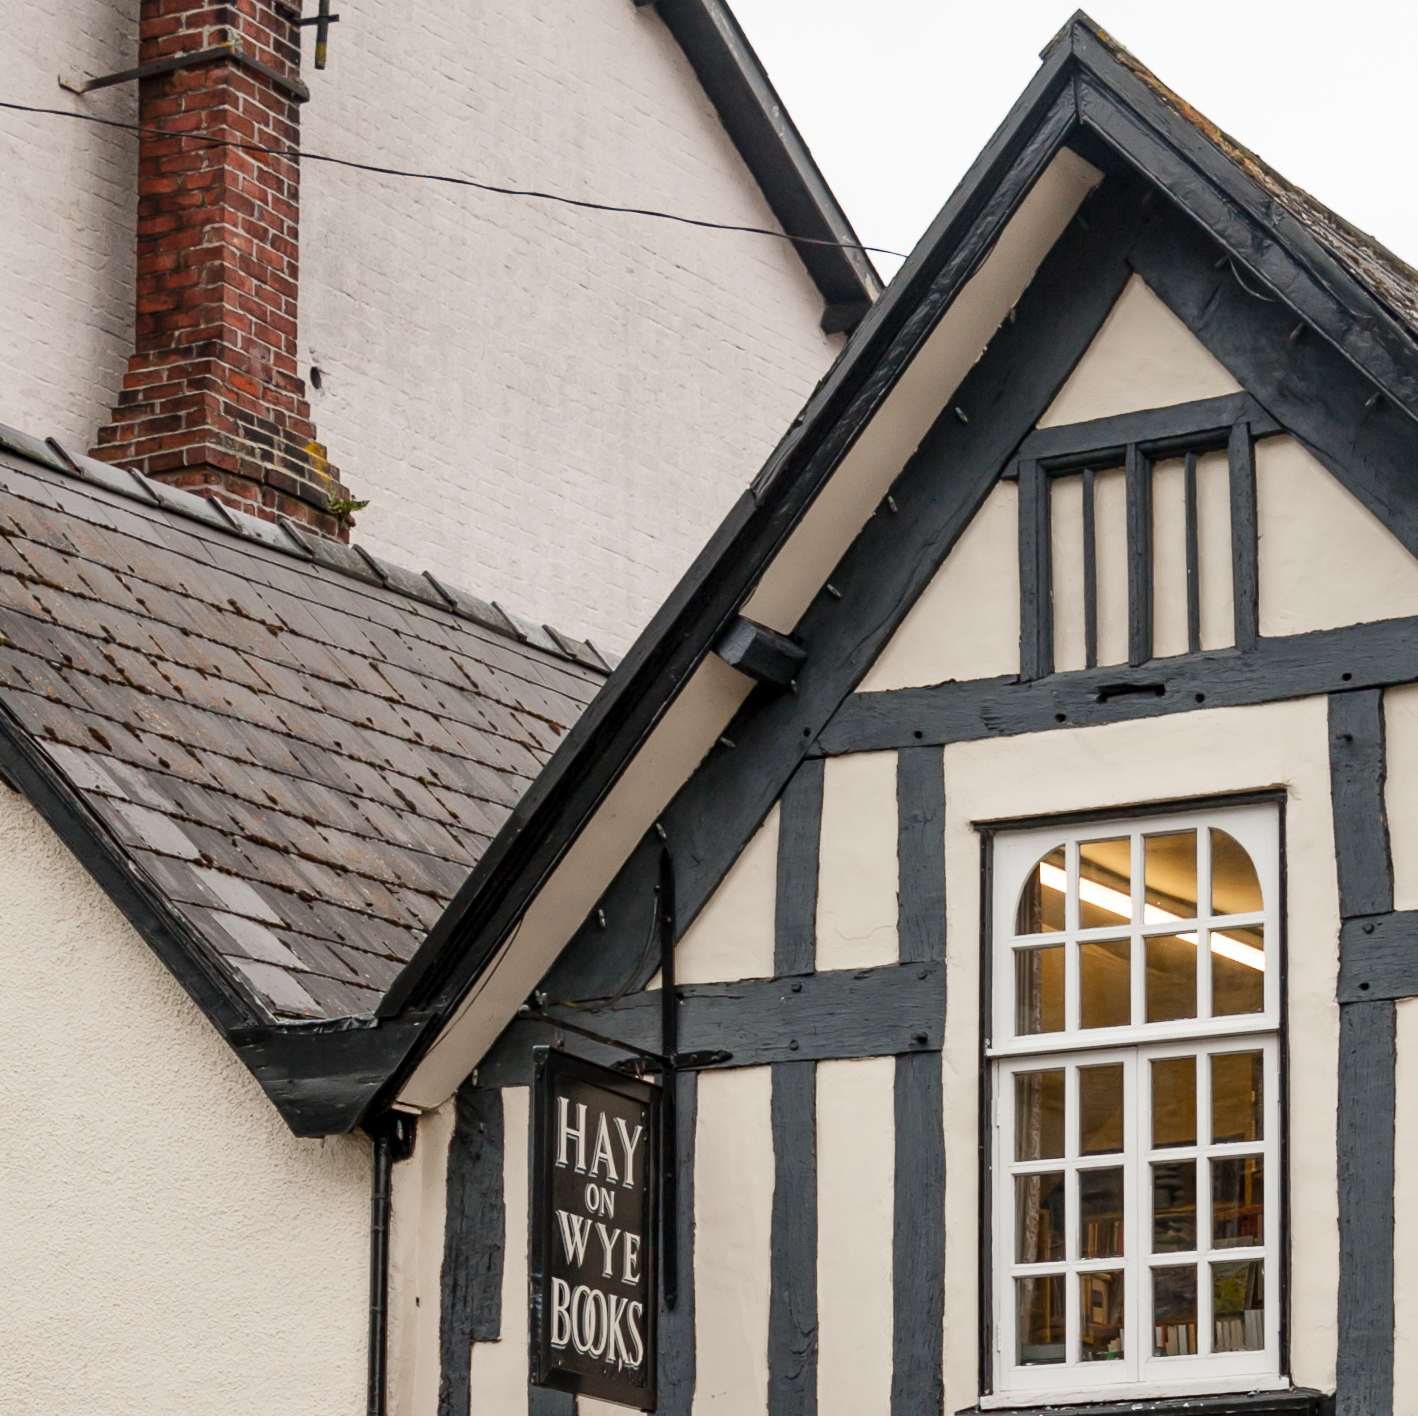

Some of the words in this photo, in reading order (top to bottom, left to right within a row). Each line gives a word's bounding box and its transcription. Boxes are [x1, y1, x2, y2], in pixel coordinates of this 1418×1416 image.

[555, 1096, 643, 1189] HAY
[585, 1183, 615, 1219] ON
[555, 1209, 641, 1286] WYE
[550, 1276, 643, 1370] BOOKS
